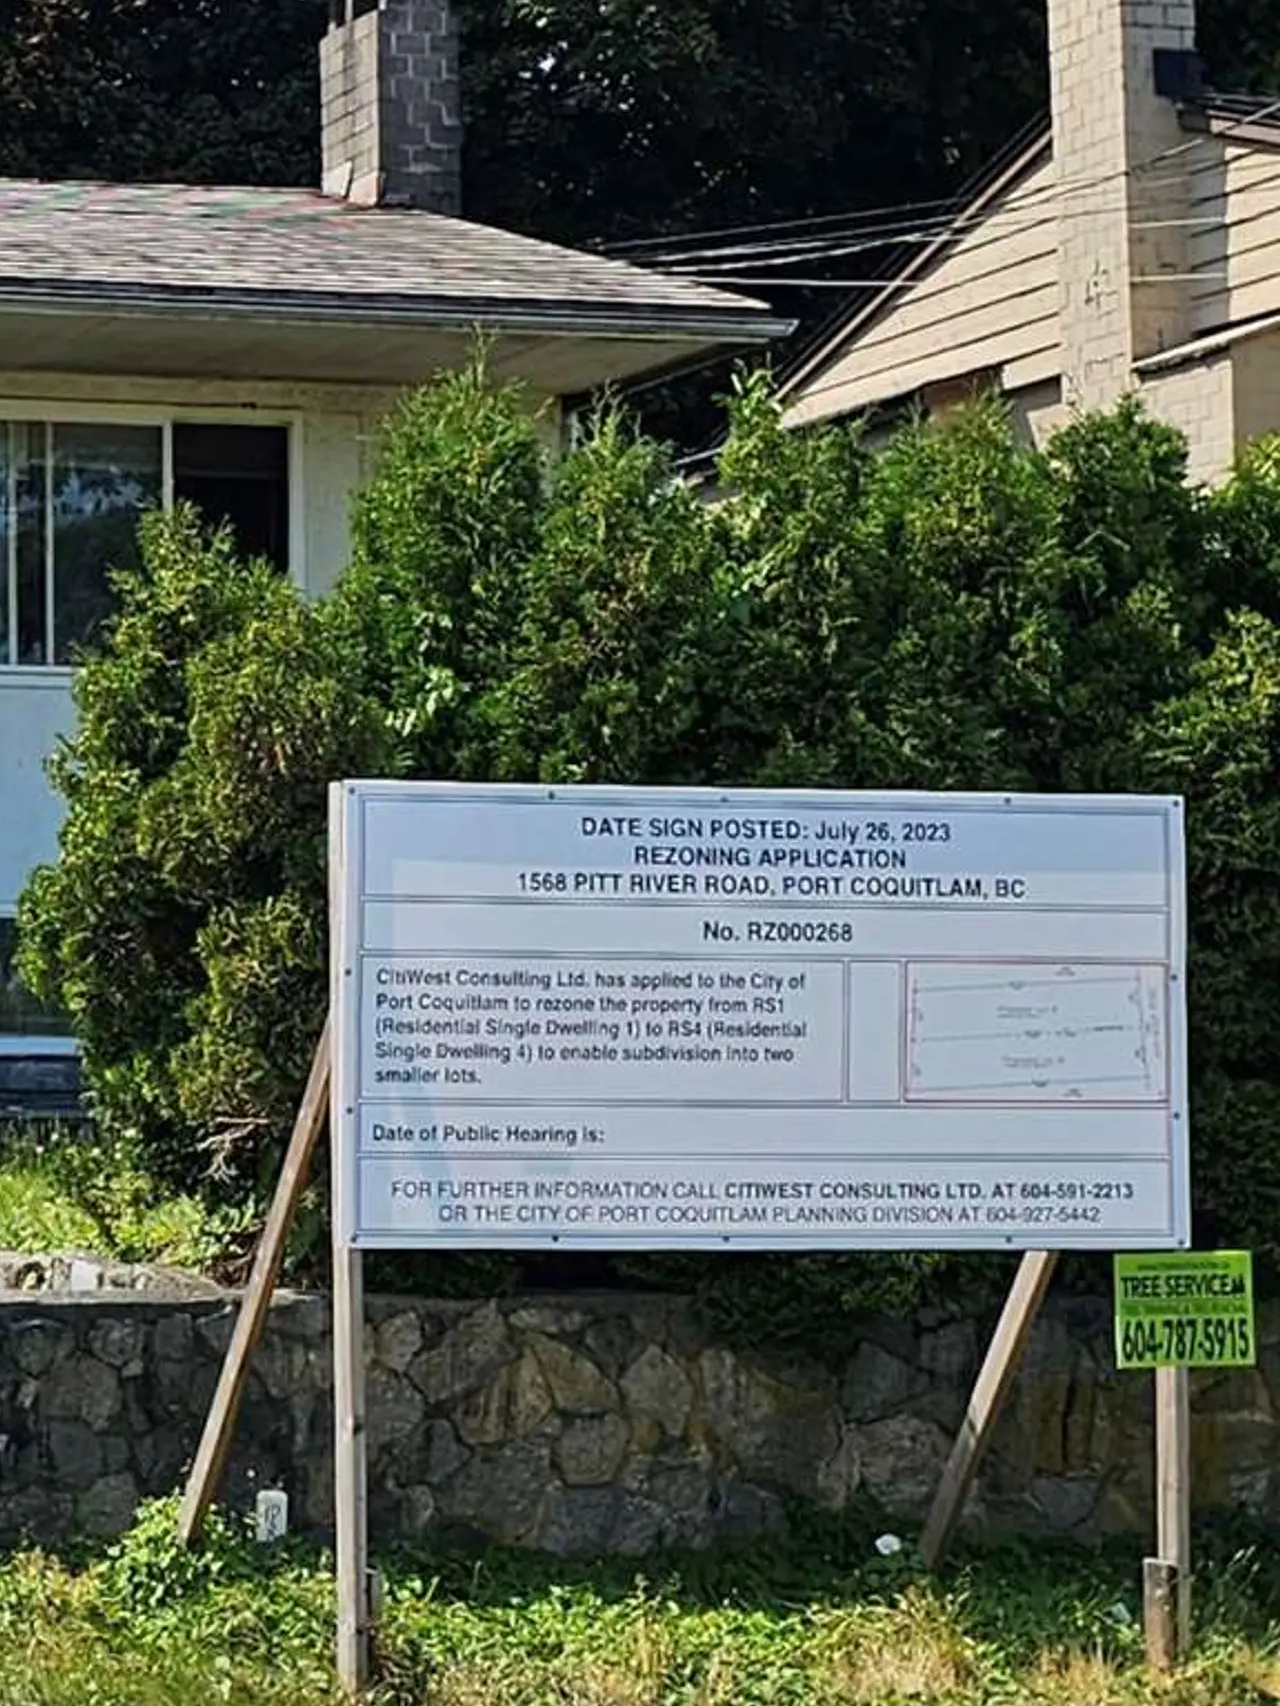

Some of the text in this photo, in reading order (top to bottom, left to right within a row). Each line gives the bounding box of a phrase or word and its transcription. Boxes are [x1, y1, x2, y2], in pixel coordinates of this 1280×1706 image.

[581, 817, 952, 843] DATE SIGN POSTED: July 26, 2023
[634, 846, 906, 868] REZONING APPLICATION
[518, 872, 567, 892] 1568
[574, 873, 622, 893] PITT
[630, 873, 697, 893] RIVER
[782, 876, 844, 895] PORT
[851, 877, 988, 899] COQUITLAM,
[995, 879, 1026, 898] BC
[703, 921, 853, 942] No. RZ000268
[376, 968, 806, 992] CitiWest Consulting Ltd. has applied to the City of
[376, 993, 784, 1016] Port Coquitlam to rezone the property from RS1
[375, 1017, 807, 1042] (Residential Single Dwelling 1) to RS4 (Residential
[375, 1042, 794, 1064] Single Dwelling 4) to enable subdivision into two
[375, 1067, 482, 1084] smaller lots.
[372, 1124, 605, 1145] Date of Public Hearing is:
[391, 1181, 1134, 1200] FOR FURTHER INFORMATION CALL CITIWEST CONSULTING LTD. AT 604-591-2213
[439, 1206, 468, 1222] OR
[475, 1206, 514, 1222] THE
[516, 1206, 562, 1222] CITY
[565, 1206, 595, 1222] OF
[599, 1206, 649, 1222] PORT
[655, 1206, 767, 1223] COQUITLAM
[773, 1207, 867, 1223] PLANNING
[873, 1207, 953, 1223] DIVISION
[958, 1207, 981, 1223] AT
[1120, 1274, 1162, 1298] TREE
